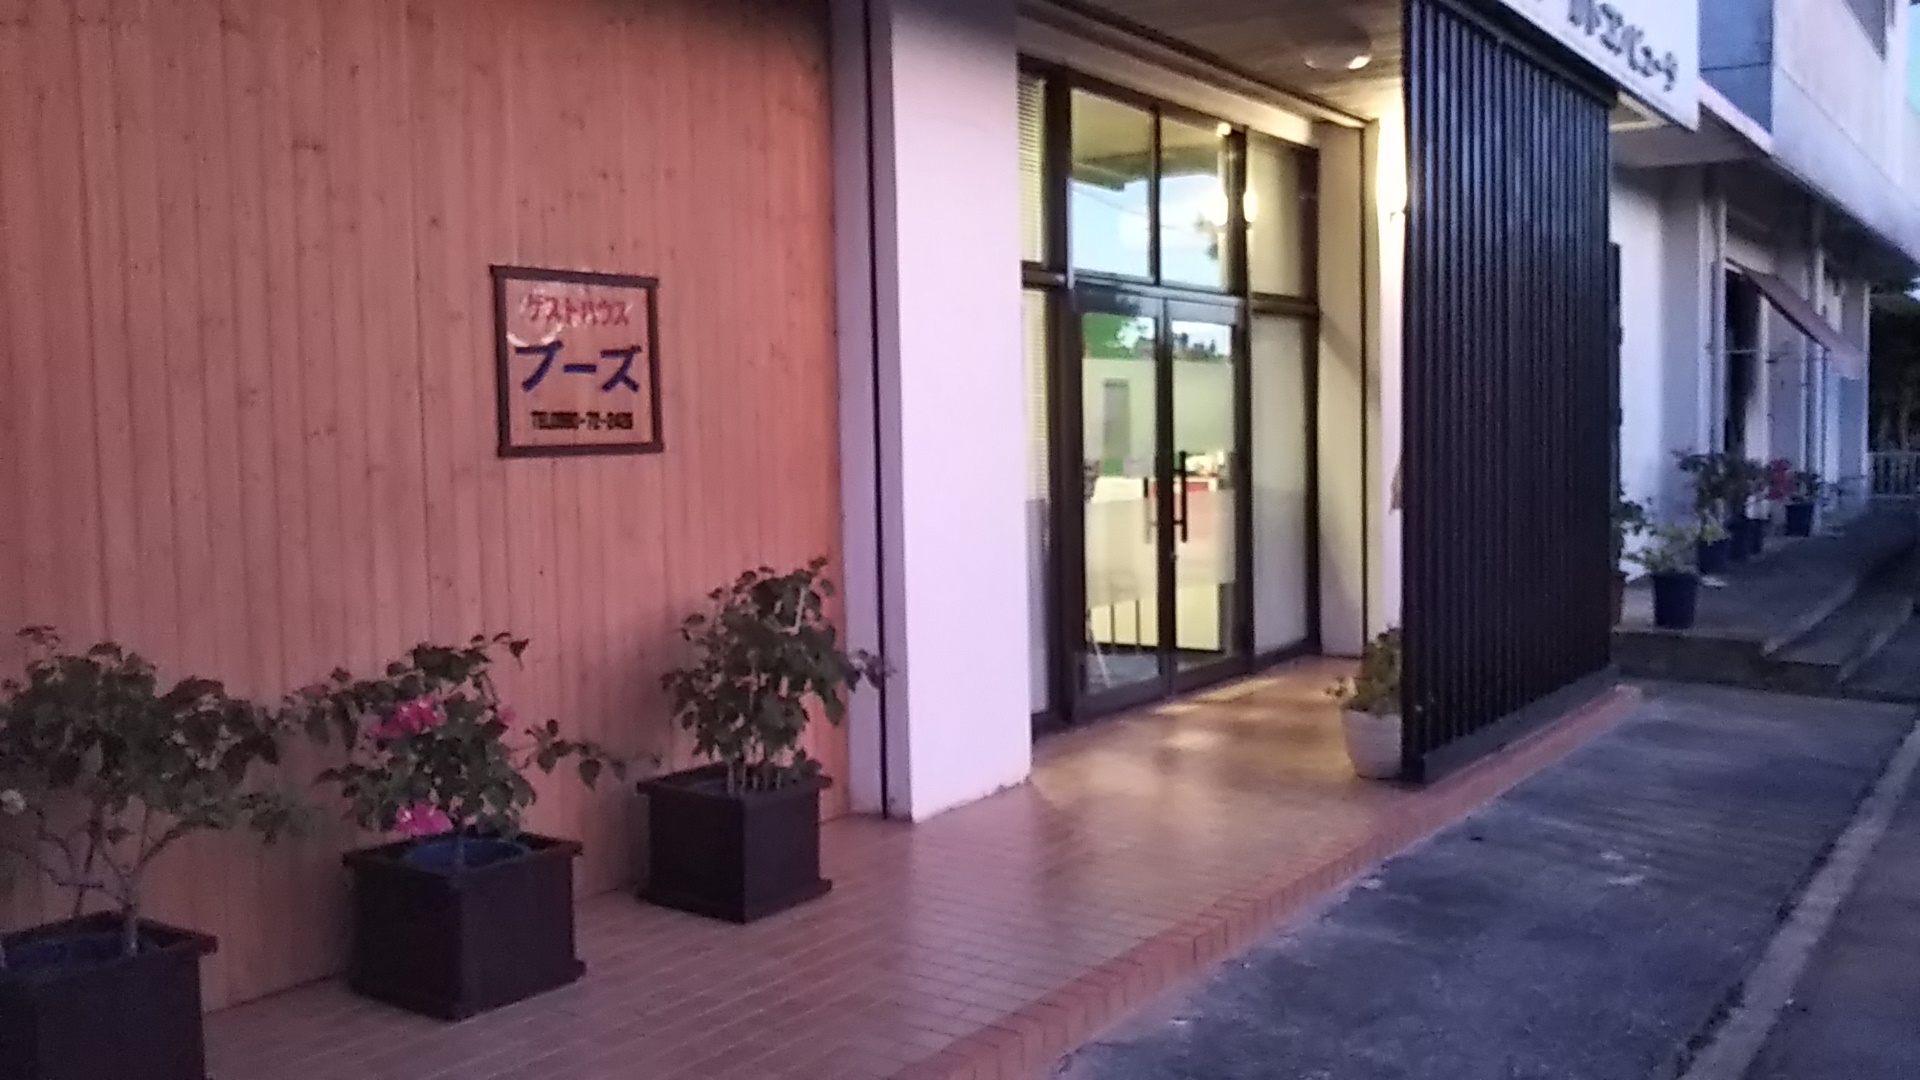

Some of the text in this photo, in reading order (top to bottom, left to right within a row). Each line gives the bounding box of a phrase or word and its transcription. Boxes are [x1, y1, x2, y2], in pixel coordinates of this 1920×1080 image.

[523, 293, 630, 326] ゲストハウス
